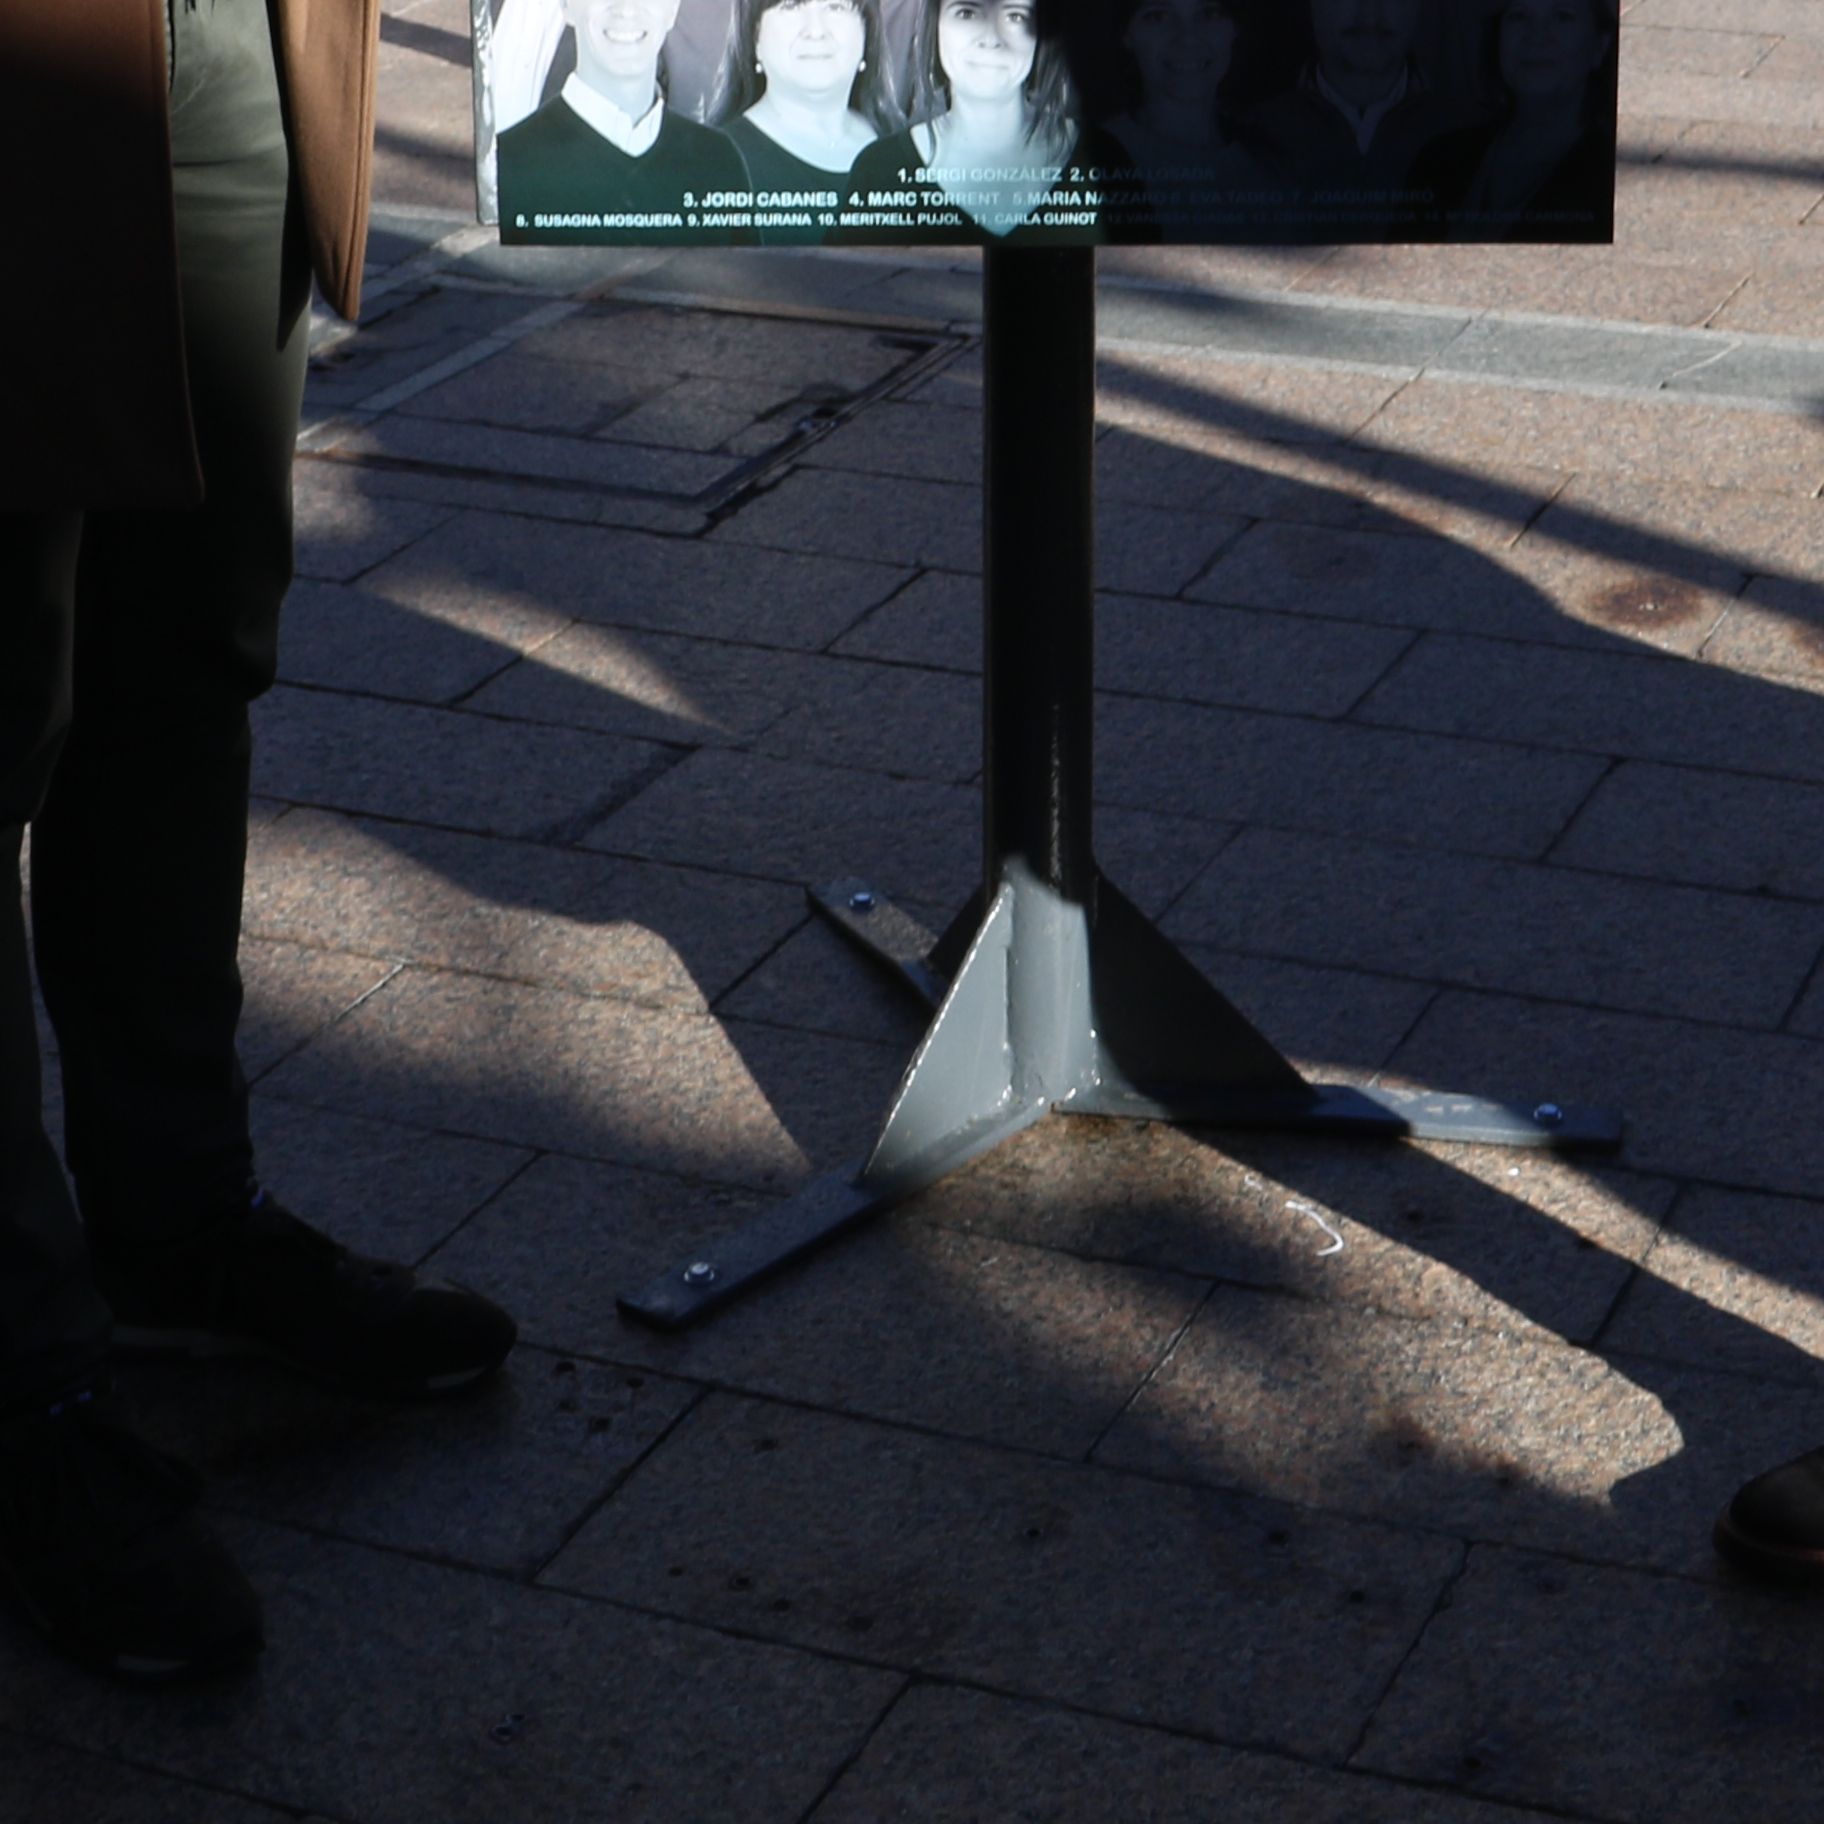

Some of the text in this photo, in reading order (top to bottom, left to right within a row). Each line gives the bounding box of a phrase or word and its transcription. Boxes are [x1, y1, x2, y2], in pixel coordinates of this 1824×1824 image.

[897, 167, 912, 183] 1.
[914, 167, 966, 183] SERGI
[970, 164, 1063, 182] GONZÁLEZ
[683, 192, 698, 208] 3.
[701, 192, 754, 208] JORDI
[756, 191, 838, 208] CABANES
[848, 191, 864, 207] 4.
[867, 191, 917, 207] MARC
[920, 191, 1000, 206] TORRENT
[534, 214, 601, 228] SUSAGNA
[603, 214, 683, 228] MOSQUERA
[701, 213, 752, 227] XAVIER
[754, 213, 812, 227] SURANA
[817, 213, 837, 227] 10.
[840, 213, 915, 226] MERITXELL
[917, 213, 963, 226] PUJOL
[996, 212, 1042, 226] CARLA
[1043, 212, 1098, 226] GUINOT
